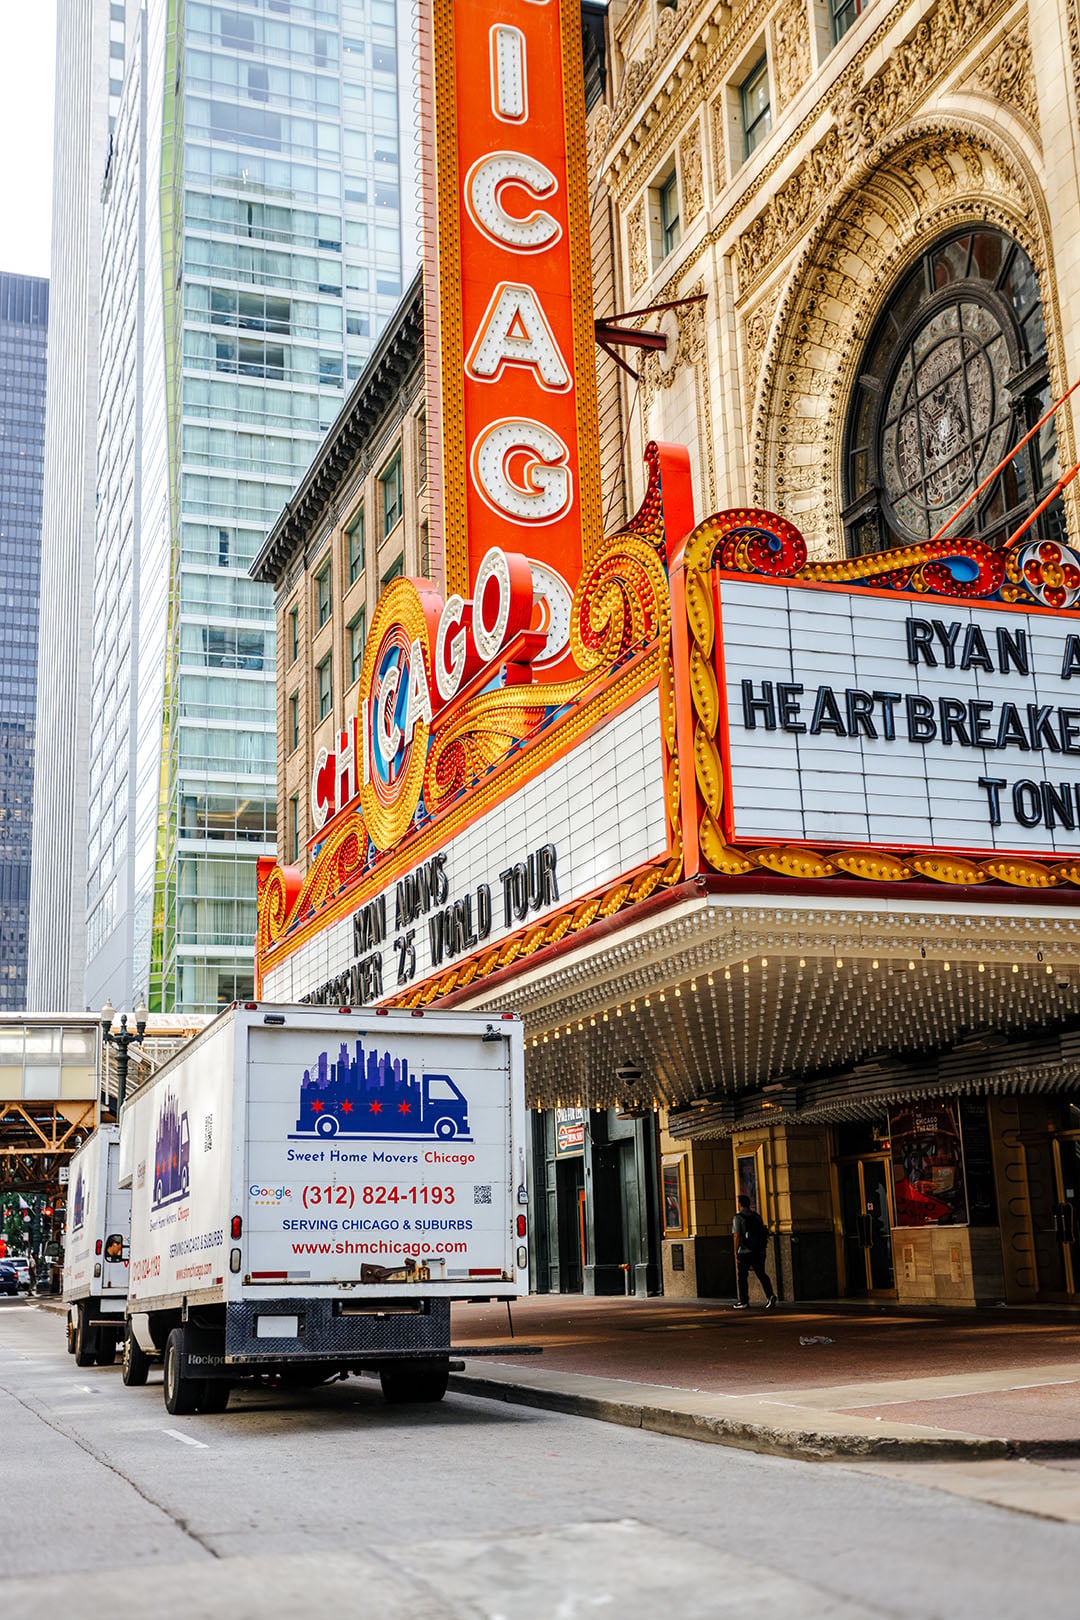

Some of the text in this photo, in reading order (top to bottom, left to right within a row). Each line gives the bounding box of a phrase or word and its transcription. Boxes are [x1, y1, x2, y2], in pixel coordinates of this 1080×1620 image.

[906, 616, 1029, 676] RYAN
[311, 546, 511, 829] CHICAGO
[353, 852, 449, 958] RYAN ADAMS
[428, 883, 492, 968] WORLD
[499, 843, 559, 929] TOUR
[287, 1149, 475, 1166] Sweet Home Movers Chicago
[249, 1184, 291, 1200] Google
[302, 1186, 455, 1209] (312) 824-1193
[282, 1219, 473, 1231] SERVING CHICAGO & SUBURBS
[291, 1240, 468, 1257] www.shmchicago.com
